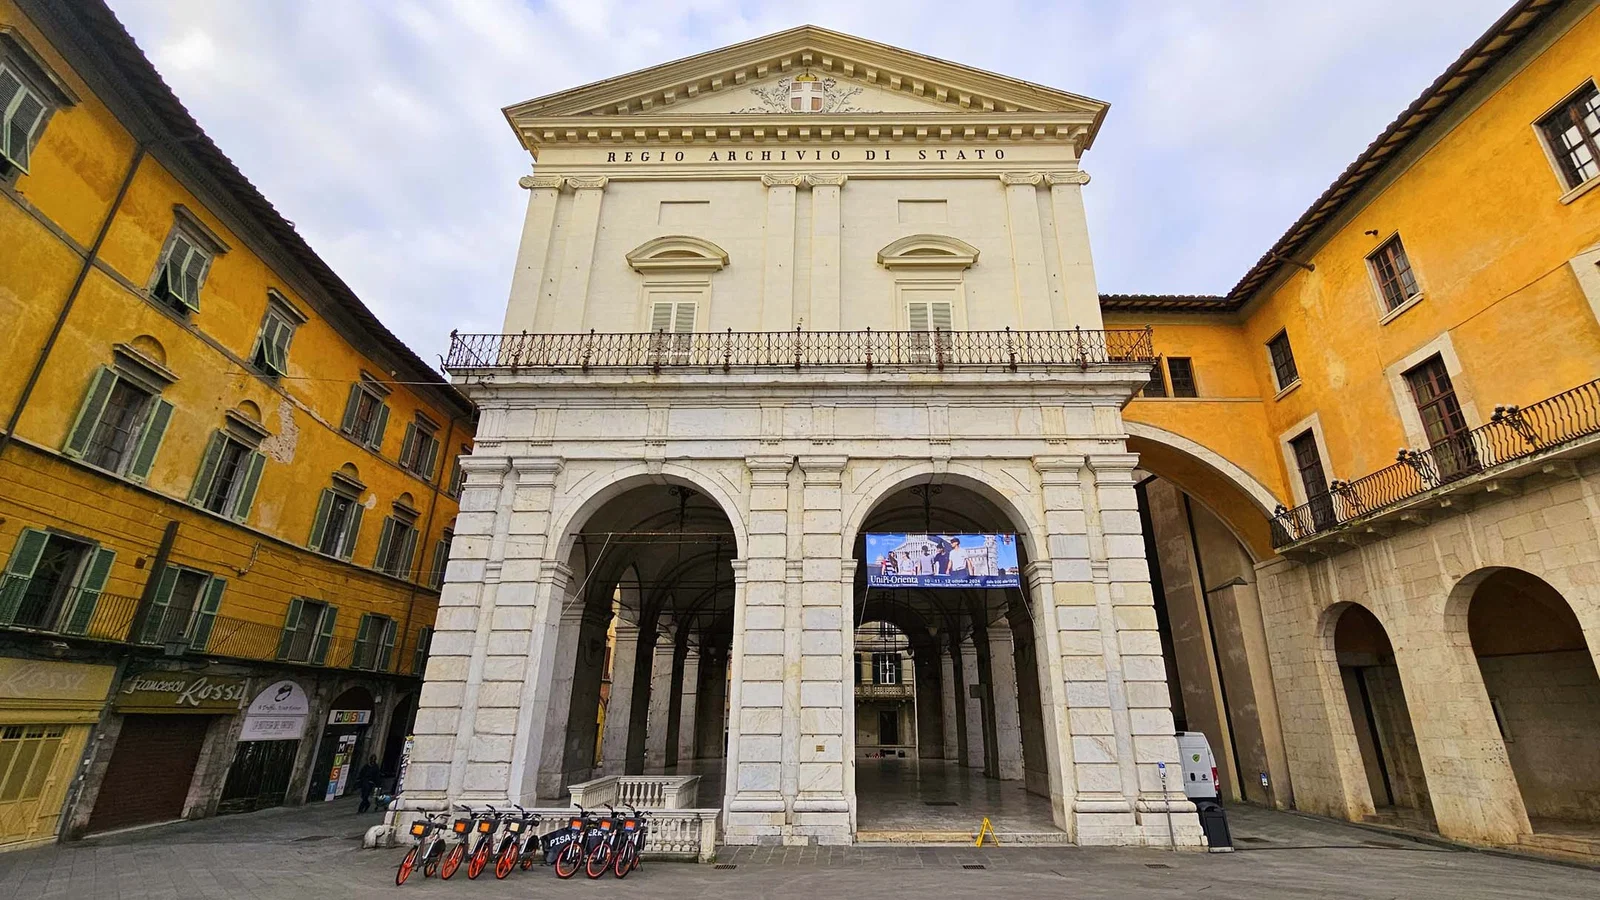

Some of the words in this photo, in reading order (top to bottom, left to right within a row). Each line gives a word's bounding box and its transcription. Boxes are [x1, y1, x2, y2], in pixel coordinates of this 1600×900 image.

[607, 151, 685, 162] REGIO
[708, 150, 841, 162] ARCHIVIO
[865, 150, 892, 161] DI
[918, 149, 1005, 161] STATO
[870, 575, 918, 584] UniPi-Orienta
[123, 675, 185, 695] Francesco
[175, 677, 246, 707] Rossi
[336, 712, 366, 722] MUST
[328, 742, 346, 794] MUST
[550, 834, 571, 847] PISA
